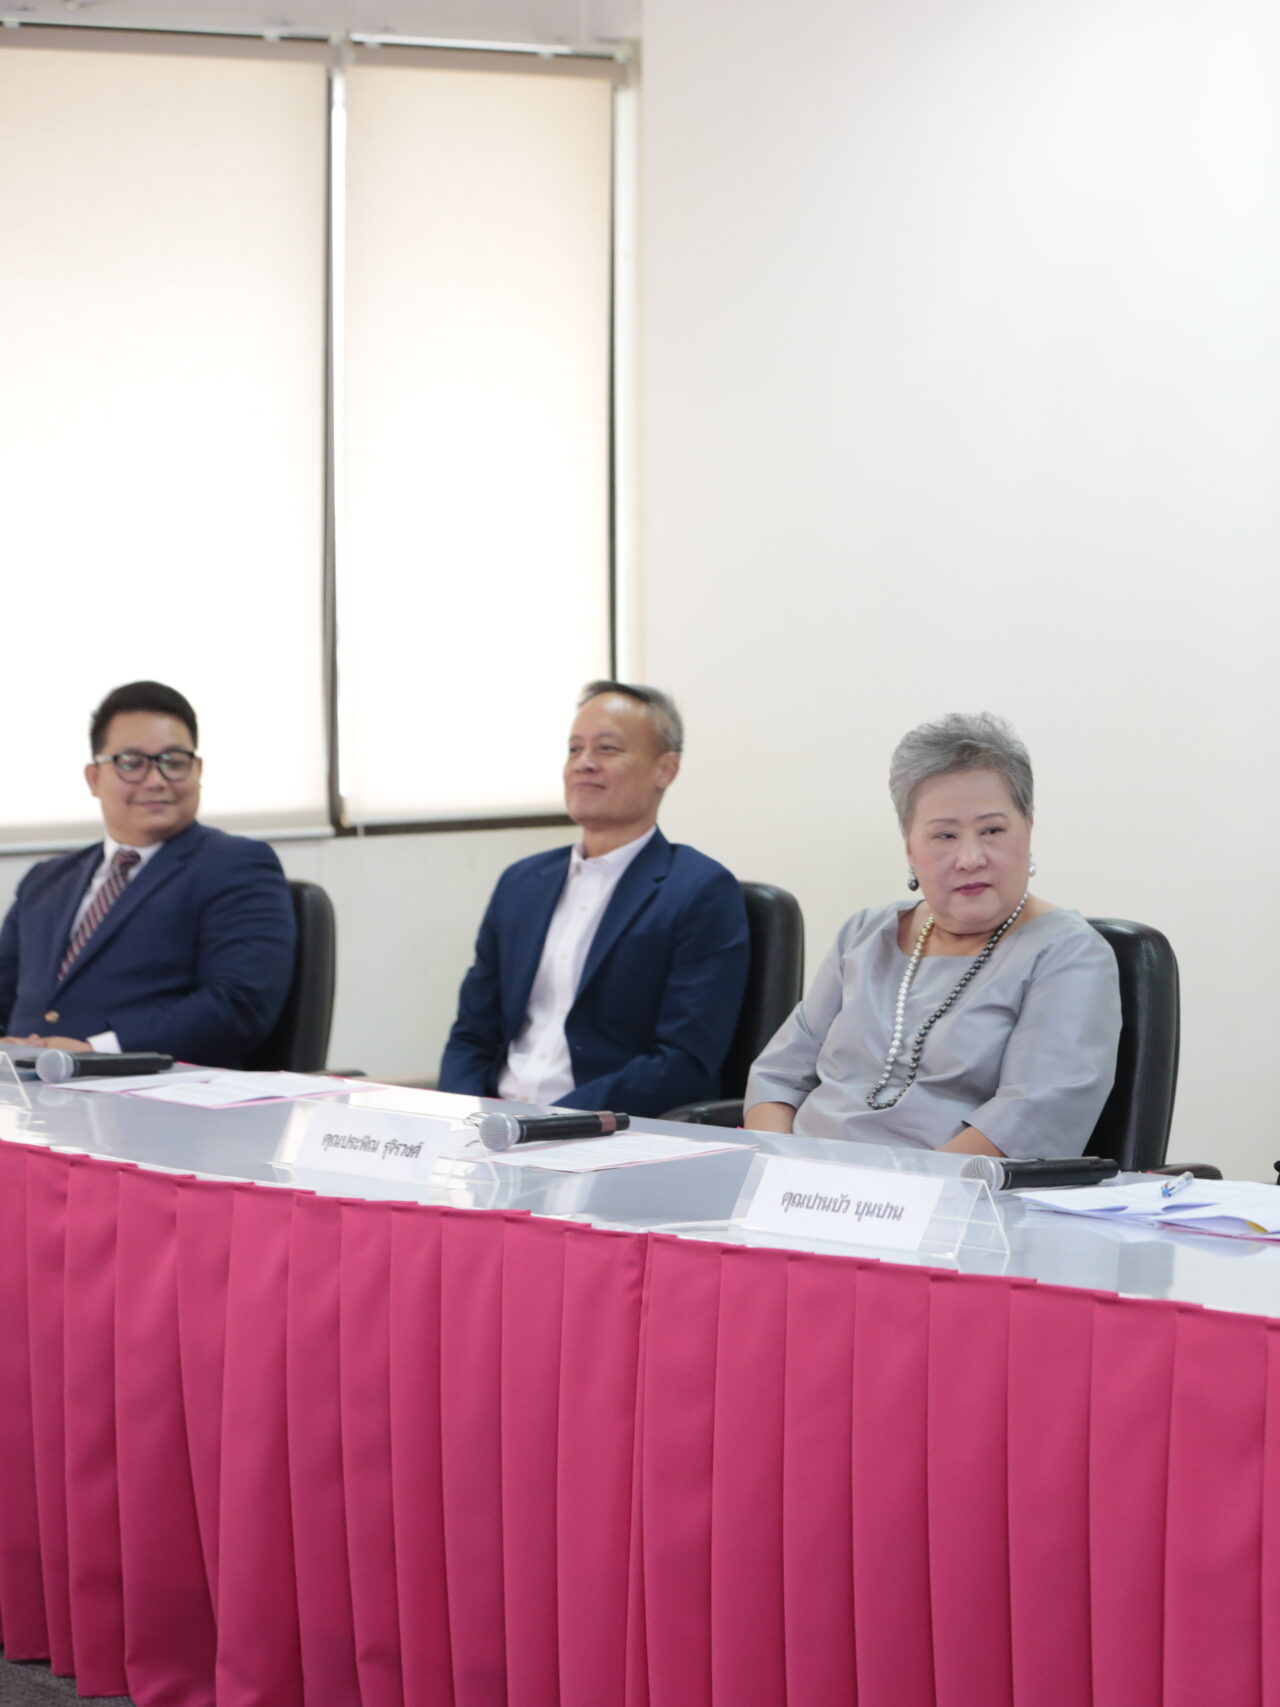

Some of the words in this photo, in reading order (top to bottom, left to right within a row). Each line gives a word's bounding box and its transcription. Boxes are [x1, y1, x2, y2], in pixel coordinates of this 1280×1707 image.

[781, 1191, 851, 1214] คุณปานบัว
[854, 1200, 905, 1222] บุนปาน
